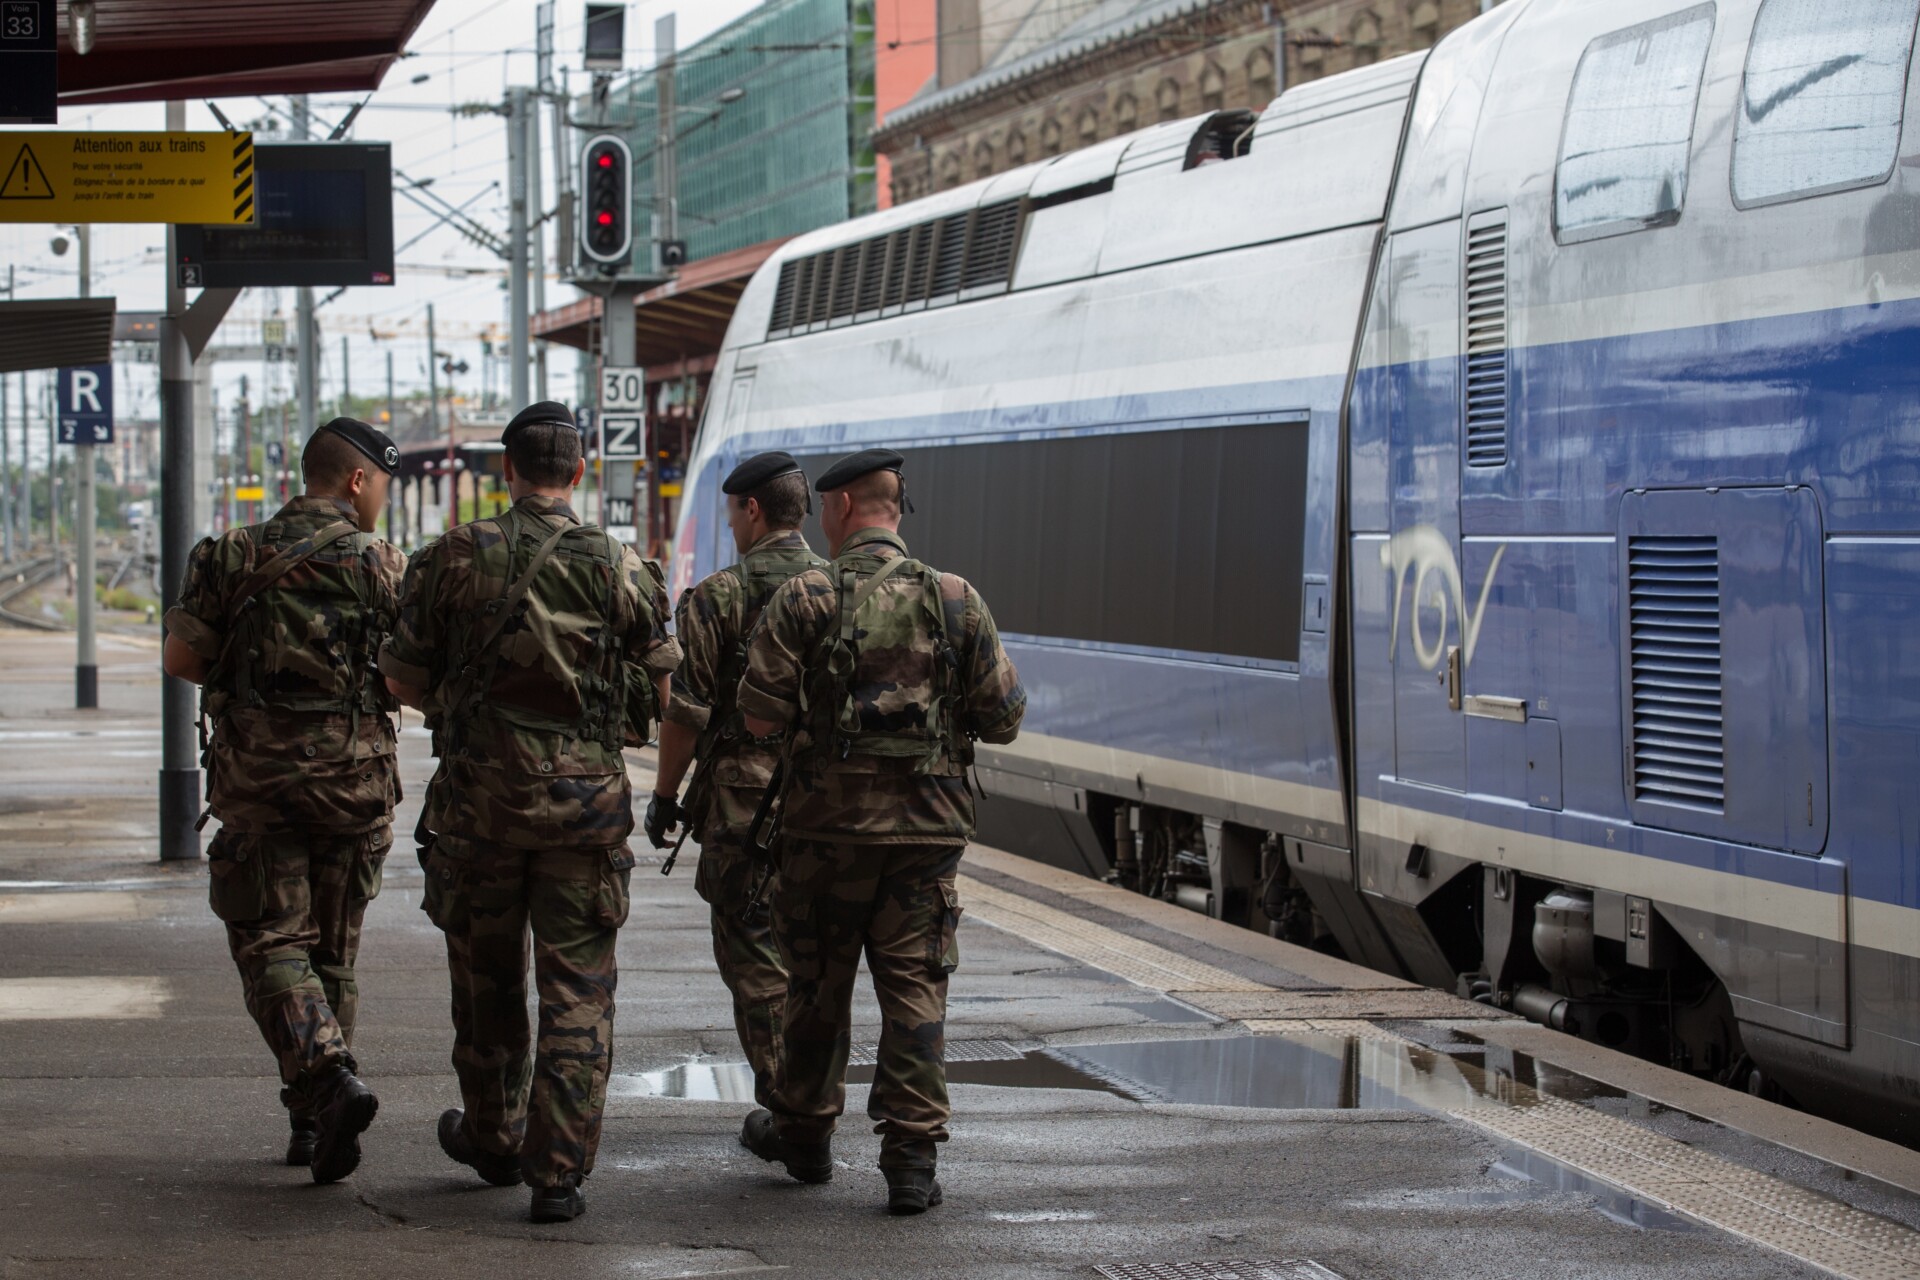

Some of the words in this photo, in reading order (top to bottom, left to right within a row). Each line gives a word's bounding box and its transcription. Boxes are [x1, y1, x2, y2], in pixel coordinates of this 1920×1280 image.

[10, 4, 30, 13] Voie
[7, 16, 34, 35] 33
[72, 137, 133, 153] Attention
[138, 139, 162, 153] aux
[169, 137, 206, 153] trains
[72, 162, 89, 171] Pour
[93, 163, 111, 171] votre
[114, 162, 143, 171] sécurité
[126, 177, 136, 186] de
[138, 177, 145, 186] la
[147, 177, 175, 186] bordure
[178, 177, 187, 186] du
[189, 178, 206, 187] quai
[126, 191, 136, 200] du
[138, 191, 155, 200] train
[185, 269, 196, 284] 2
[70, 369, 103, 413] R
[605, 373, 640, 402] 30
[578, 407, 590, 427] S
[64, 426, 75, 441] 2
[606, 421, 638, 454] Z
[610, 500, 633, 524] Nr
